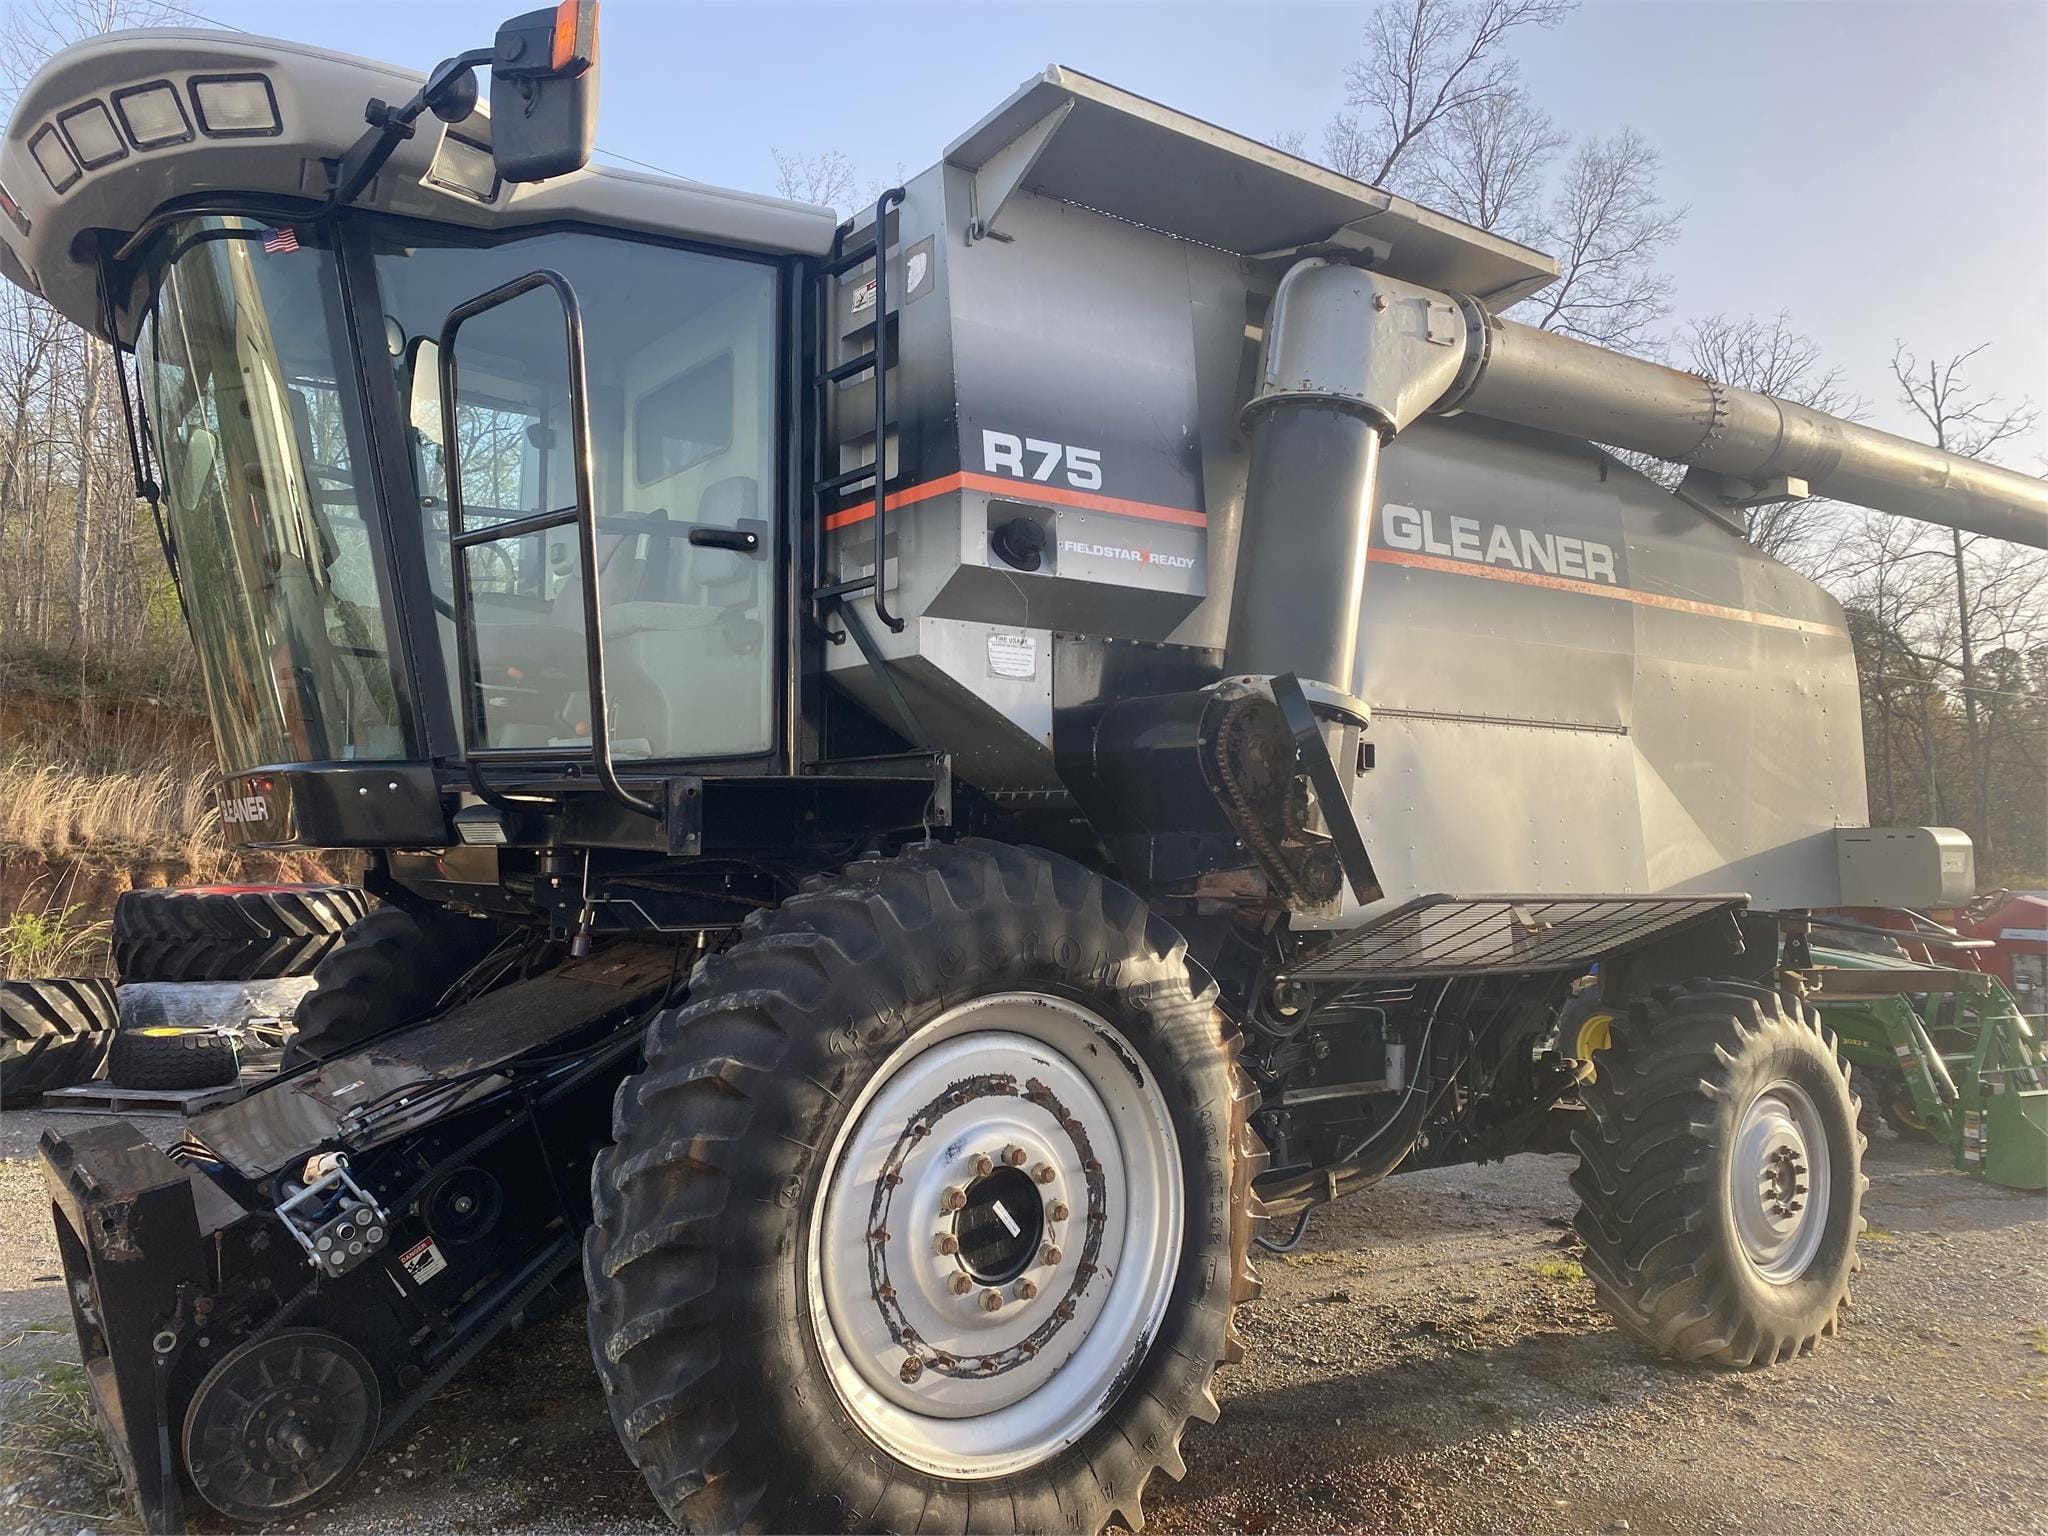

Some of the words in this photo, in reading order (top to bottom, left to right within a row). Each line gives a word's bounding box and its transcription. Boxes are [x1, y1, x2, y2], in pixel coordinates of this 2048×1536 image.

[982, 429, 1102, 490] R75
[1065, 541, 1142, 562] FIELDSTAR
[1149, 553, 1195, 569] READY
[1382, 503, 1617, 583] GLEANER
[401, 1242, 428, 1263] DANGER
